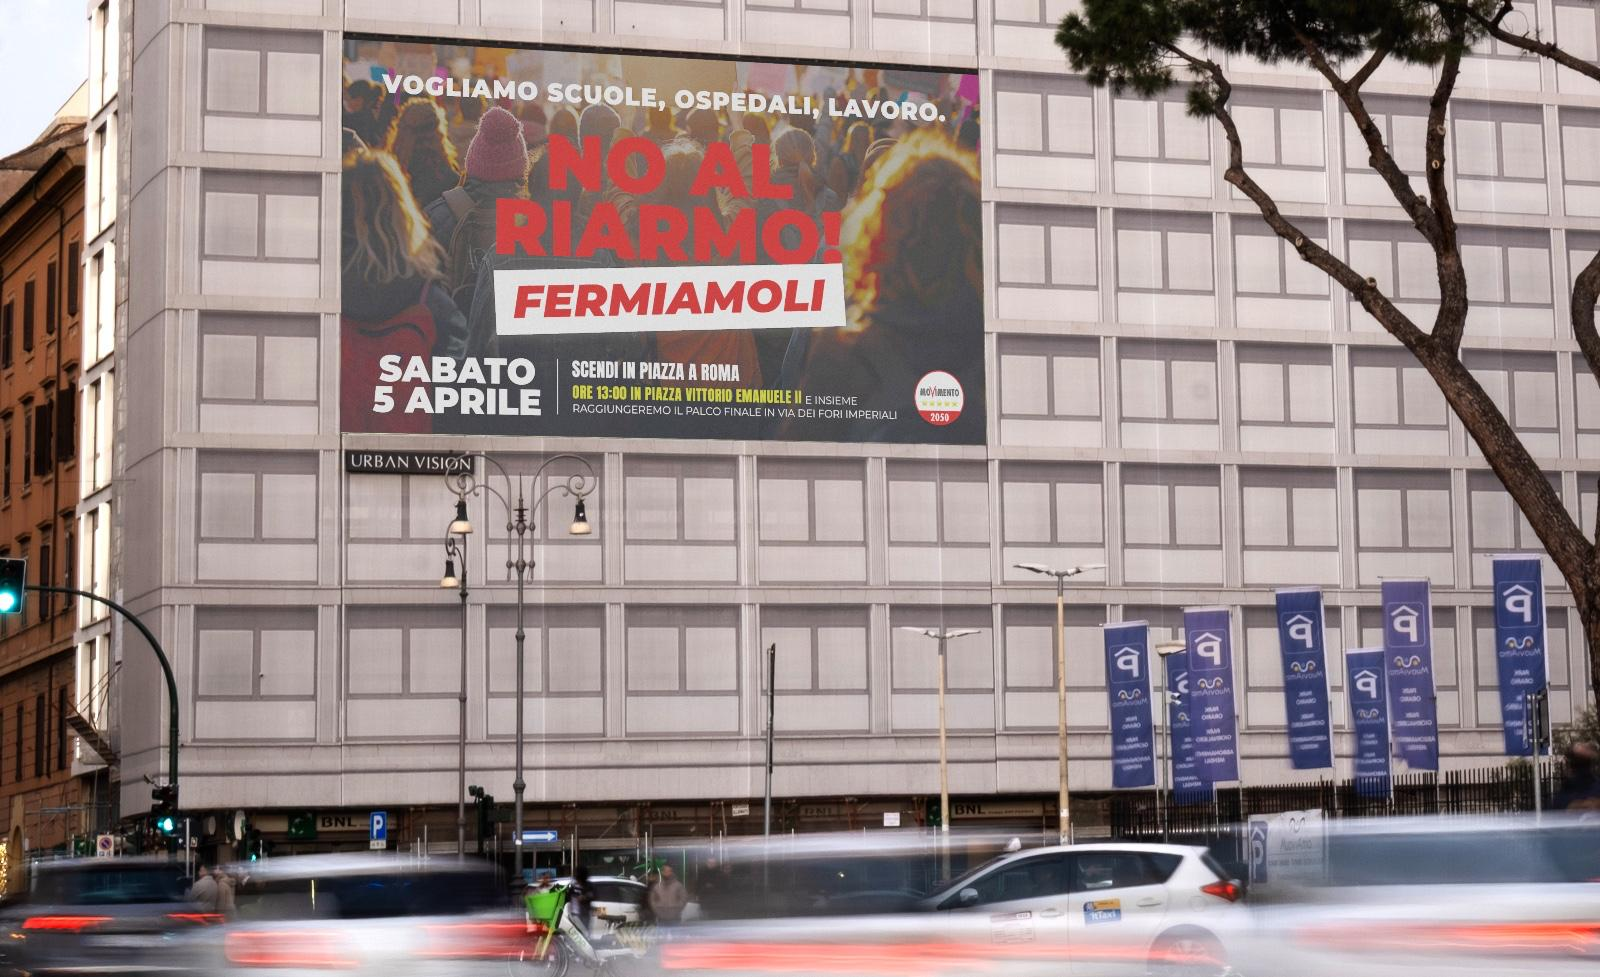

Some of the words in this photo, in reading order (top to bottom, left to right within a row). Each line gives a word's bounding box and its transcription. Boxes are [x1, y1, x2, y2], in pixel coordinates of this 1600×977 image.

[381, 74, 538, 100] VOGLIAMO
[547, 83, 666, 111] SCUOLE,
[674, 89, 820, 119] OSPEDALI,
[828, 97, 946, 122] LAVORO.
[548, 134, 667, 194] NO
[688, 142, 794, 200] AL
[495, 197, 843, 265] RIARMO!
[513, 279, 826, 319] FERMIAMOLI
[379, 354, 536, 386] SABATO
[571, 360, 619, 378] SCENDI
[622, 361, 636, 380] IN
[639, 362, 685, 381] PIAZZA
[688, 363, 698, 381] A
[701, 364, 740, 382] ROMA
[372, 385, 395, 413] 5
[404, 386, 542, 416] APRILE
[572, 385, 593, 400] ORE
[596, 385, 627, 400] 13:00
[630, 386, 641, 401] IN
[645, 386, 682, 402] PIAZZA
[685, 387, 733, 403] VITTORIO
[736, 388, 792, 404] EMANUELE
[794, 390, 802, 405] II
[805, 395, 812, 405] E
[815, 396, 858, 406] INSIEME
[572, 403, 672, 415] RAGGIUNGEREMO
[674, 406, 684, 416] IL
[686, 406, 721, 416] PALCO
[724, 407, 761, 417] FINALE
[764, 408, 775, 417] IN
[778, 408, 795, 418] VIA
[798, 408, 815, 418] DEI
[818, 409, 842, 419] FORI
[845, 410, 898, 420] IMPERIALI
[930, 412, 950, 423] 2050
[351, 454, 409, 469] URBAN
[414, 455, 471, 470] VISION
[955, 804, 986, 815] BNL
[321, 816, 357, 828] BNL
[373, 815, 384, 839] P
